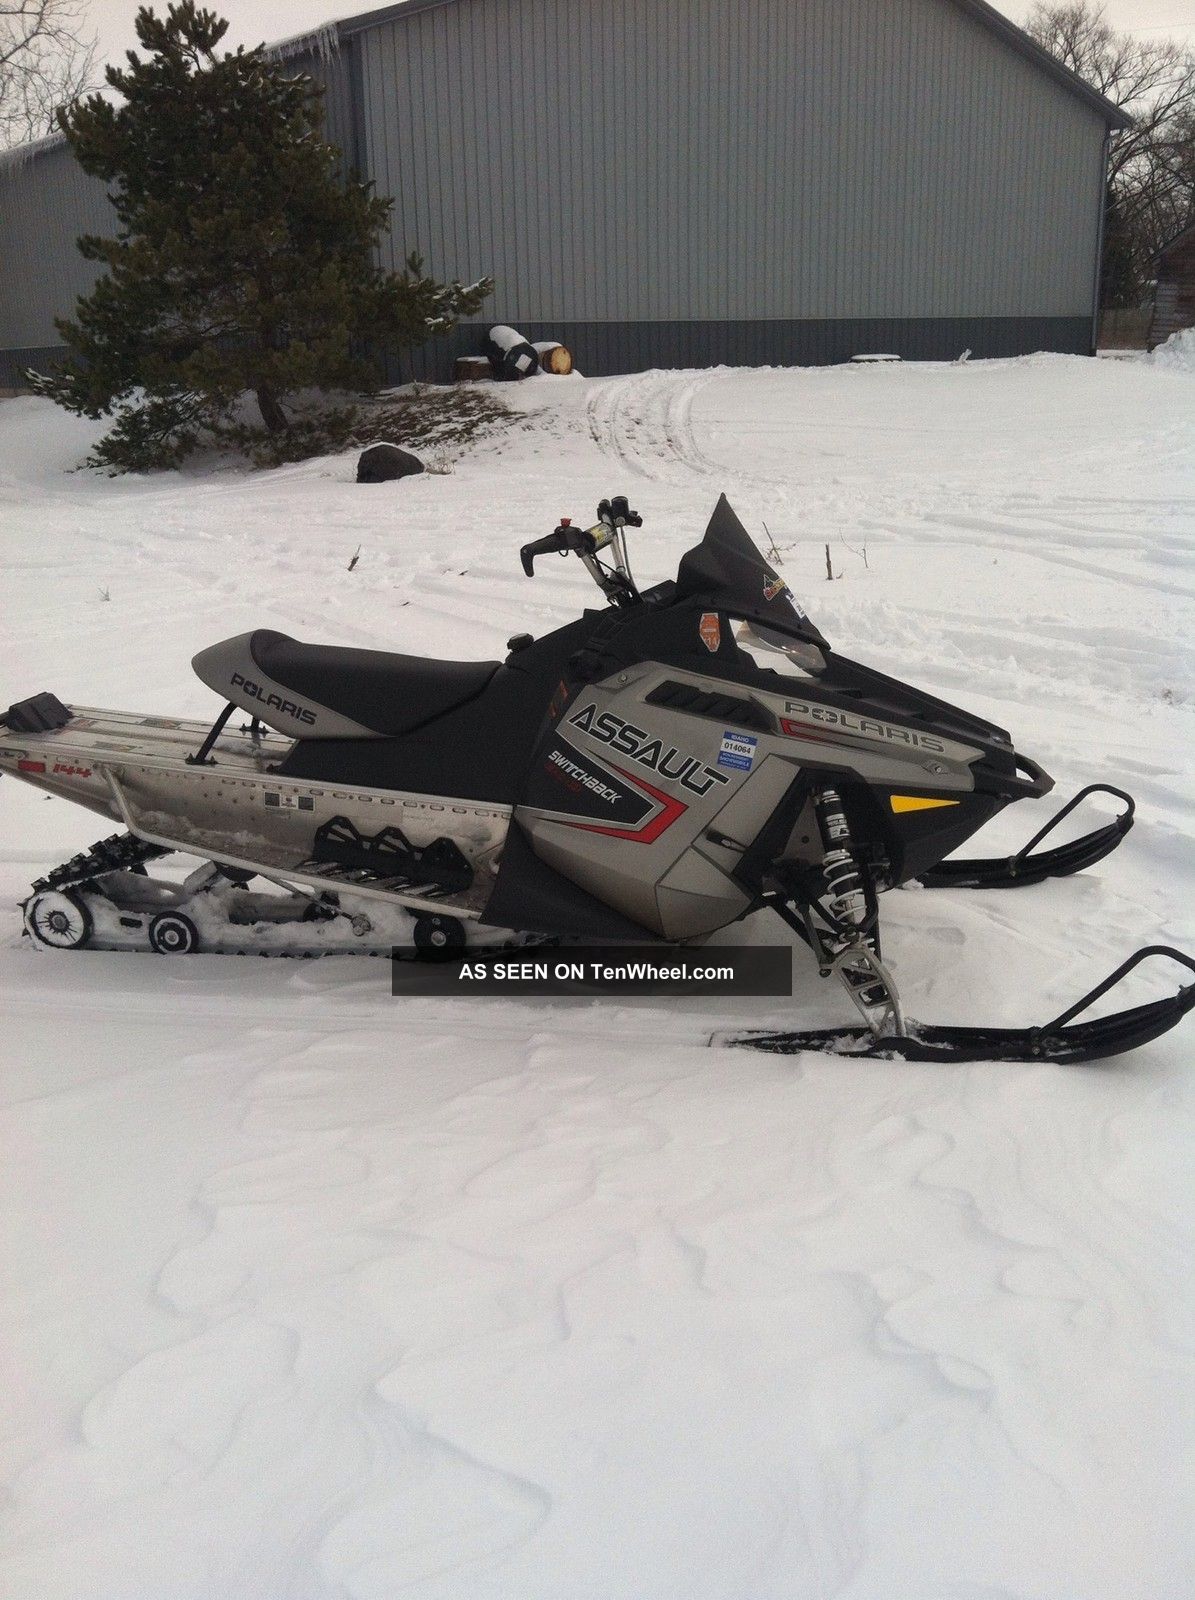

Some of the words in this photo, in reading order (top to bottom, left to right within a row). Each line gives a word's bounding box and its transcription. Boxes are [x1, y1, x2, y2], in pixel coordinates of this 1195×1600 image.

[231, 673, 318, 726] POLARIS
[567, 702, 732, 798] ASSAULT
[724, 742, 751, 754] 014064
[784, 701, 945, 753] POLARIS
[548, 750, 623, 804] SWITCHBACK
